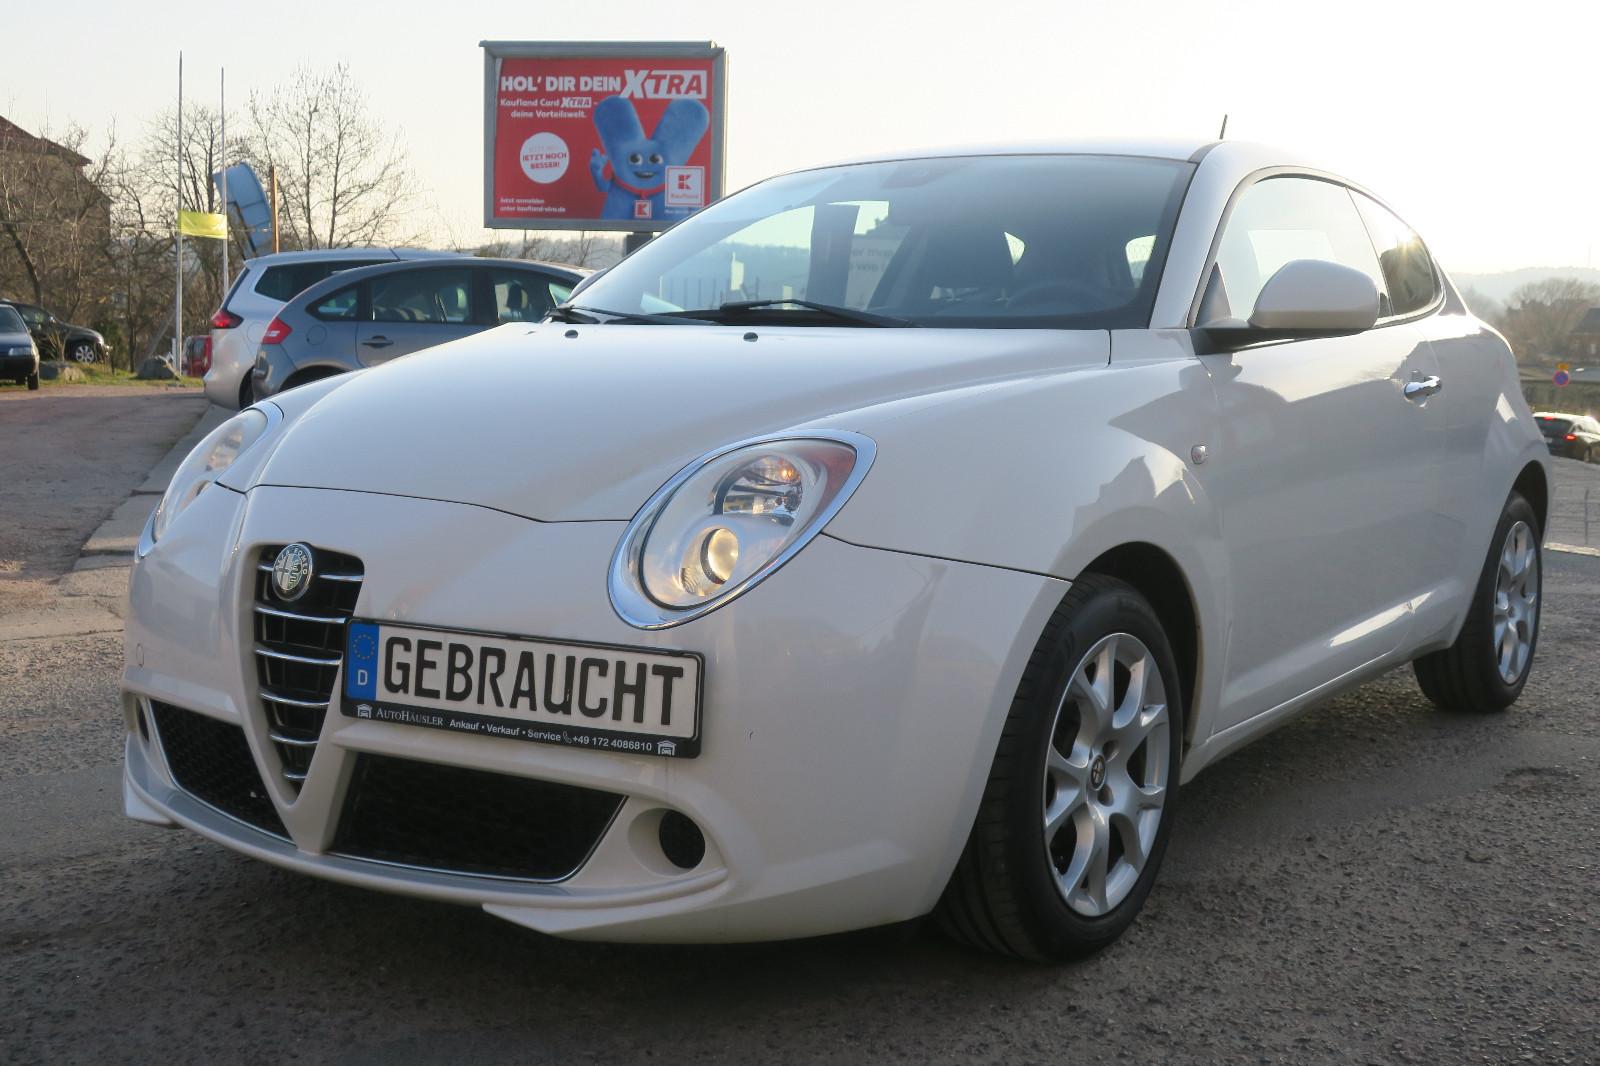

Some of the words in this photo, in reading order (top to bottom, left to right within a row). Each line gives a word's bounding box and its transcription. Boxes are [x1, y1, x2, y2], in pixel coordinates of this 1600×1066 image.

[545, 76, 576, 92] DIR
[580, 76, 620, 92] DEIN
[619, 69, 707, 99] XTRA
[500, 97, 538, 106] Kaufland
[539, 97, 560, 106] Card
[560, 97, 592, 107] XTRA
[357, 669, 368, 686] D
[384, 636, 683, 725] GEBRAUCHT
[449, 719, 480, 731] Ankauf
[486, 724, 520, 736] Verkauf
[527, 729, 561, 741] Service
[572, 735, 590, 745] +49
[591, 737, 609, 747] 172
[610, 738, 652, 752] 4086810
